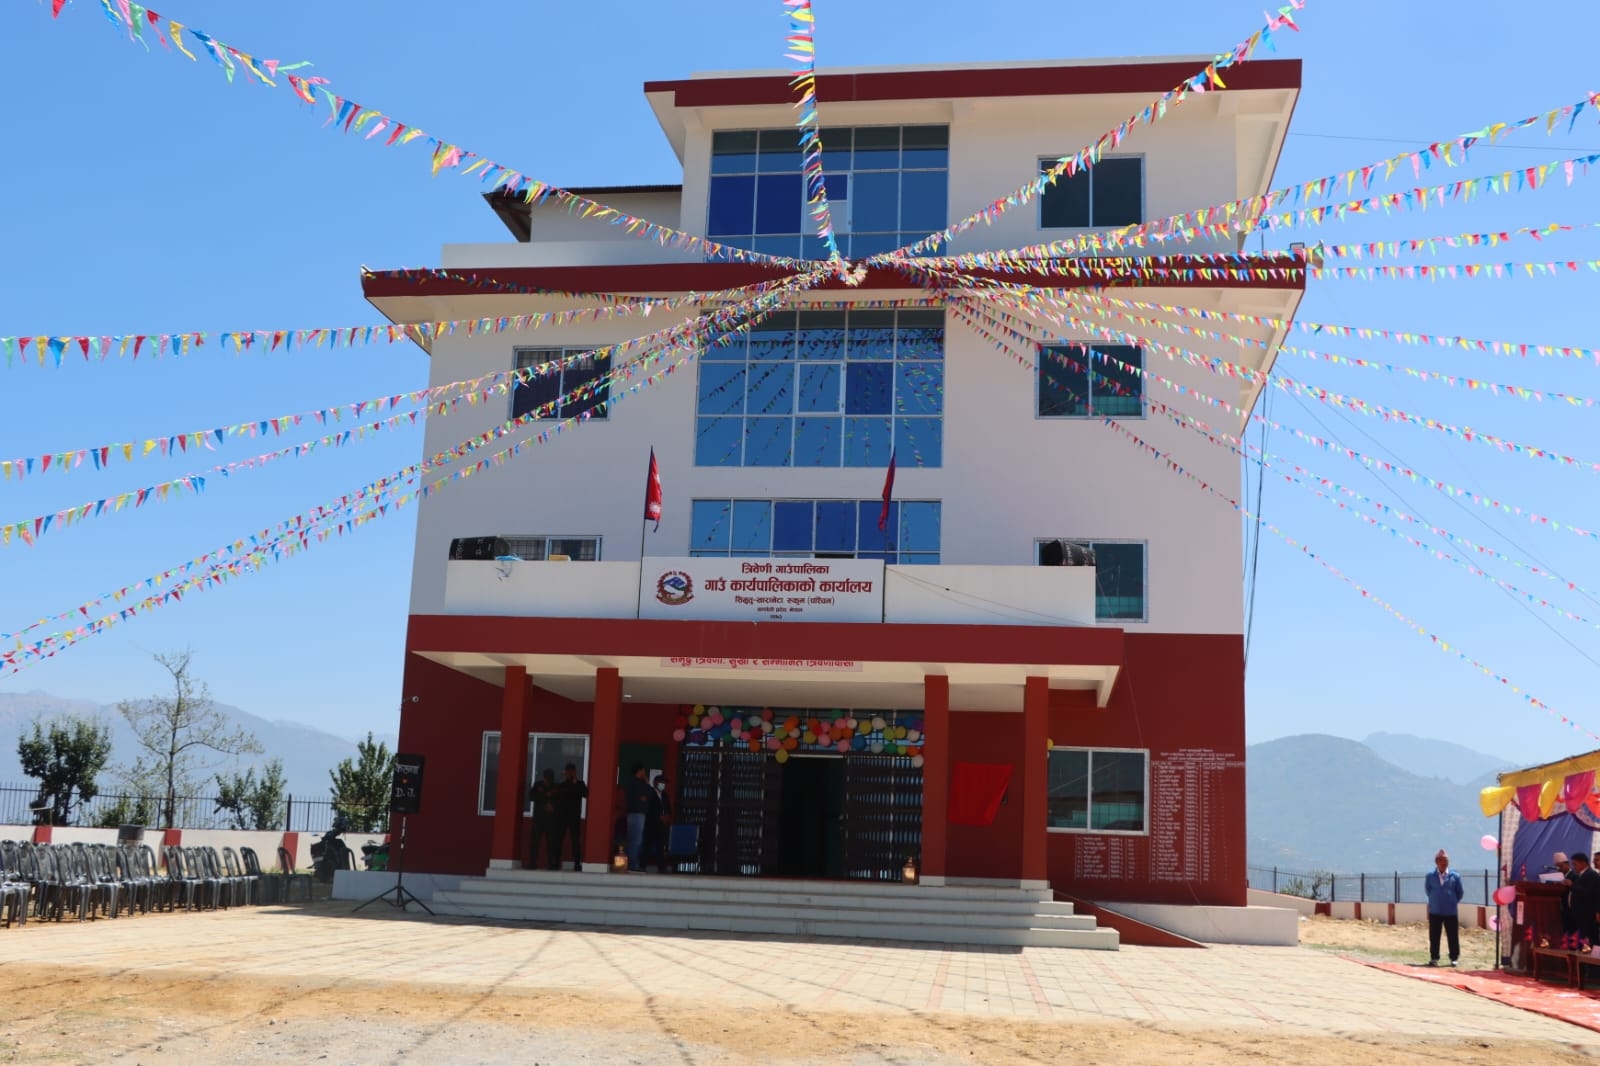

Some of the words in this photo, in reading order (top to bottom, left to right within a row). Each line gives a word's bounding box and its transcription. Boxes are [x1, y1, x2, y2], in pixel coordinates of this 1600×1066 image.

[741, 562, 771, 575] त्रिवेणी
[730, 577, 815, 593] कार्यपालिकाको
[819, 578, 872, 593] कार्यालय
